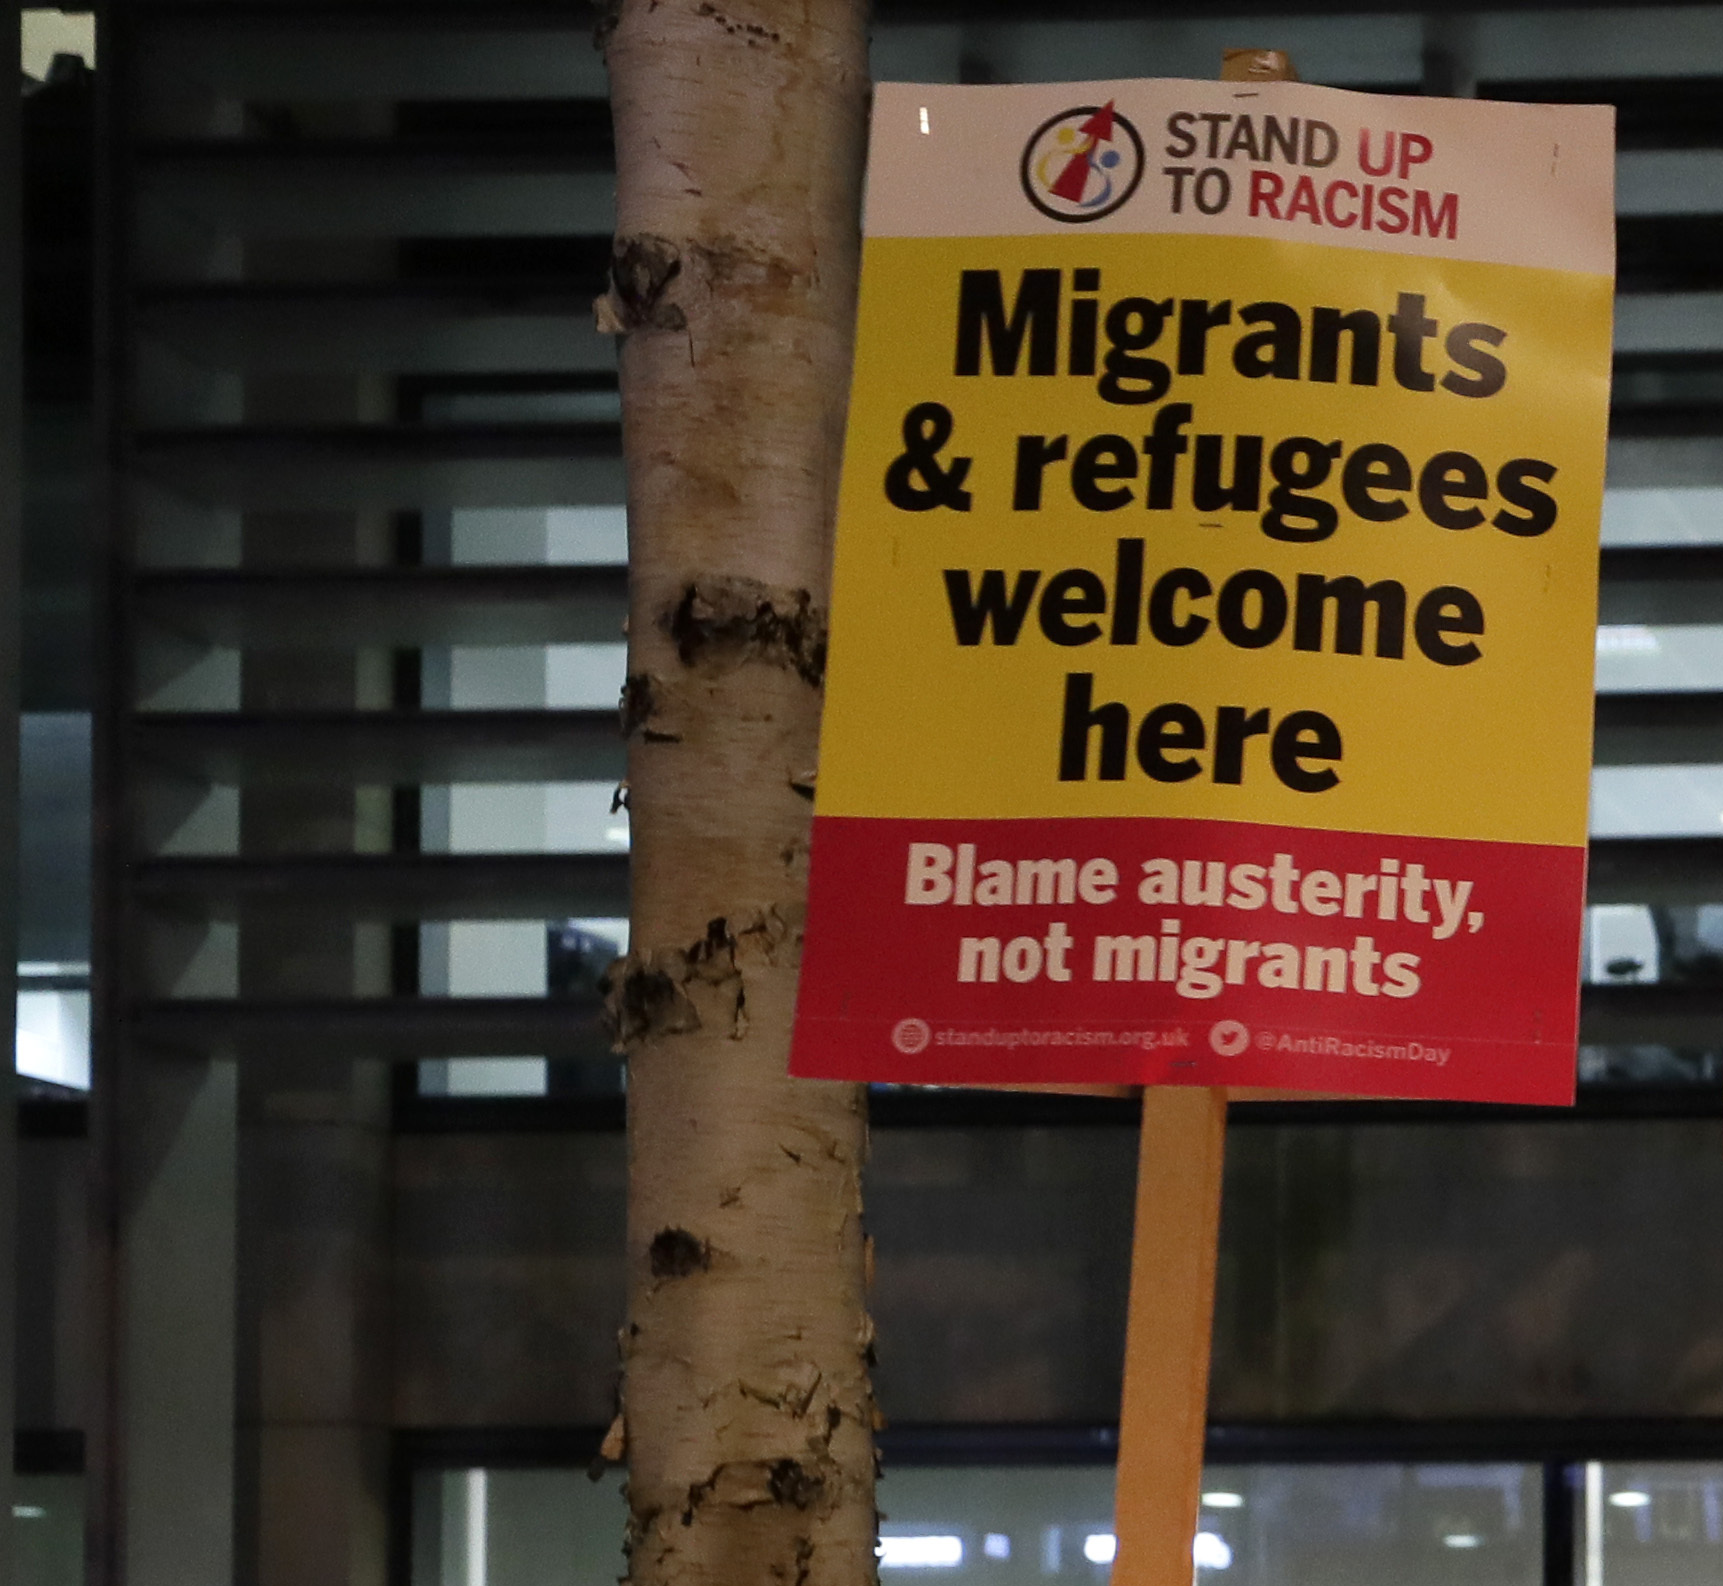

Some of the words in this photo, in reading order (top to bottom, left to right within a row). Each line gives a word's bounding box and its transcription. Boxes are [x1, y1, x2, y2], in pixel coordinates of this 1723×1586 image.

[1163, 111, 1339, 168] STAND
[1358, 130, 1433, 180] UP
[1164, 166, 1230, 215] TO
[1249, 170, 1459, 240] RACISM
[953, 267, 1508, 404] Migrants
[883, 401, 972, 512] &
[1012, 403, 1558, 543] refugees
[944, 539, 1485, 666] welcome
[1058, 673, 1342, 793] here
[904, 843, 1117, 907] Blame
[1137, 852, 1485, 939] austerity,
[957, 923, 1072, 983] not
[1092, 919, 1422, 999] migrants
[935, 1025, 1189, 1050] standuptoracism.org.uk
[1256, 1029, 1451, 1066] @AntiRacismDay
